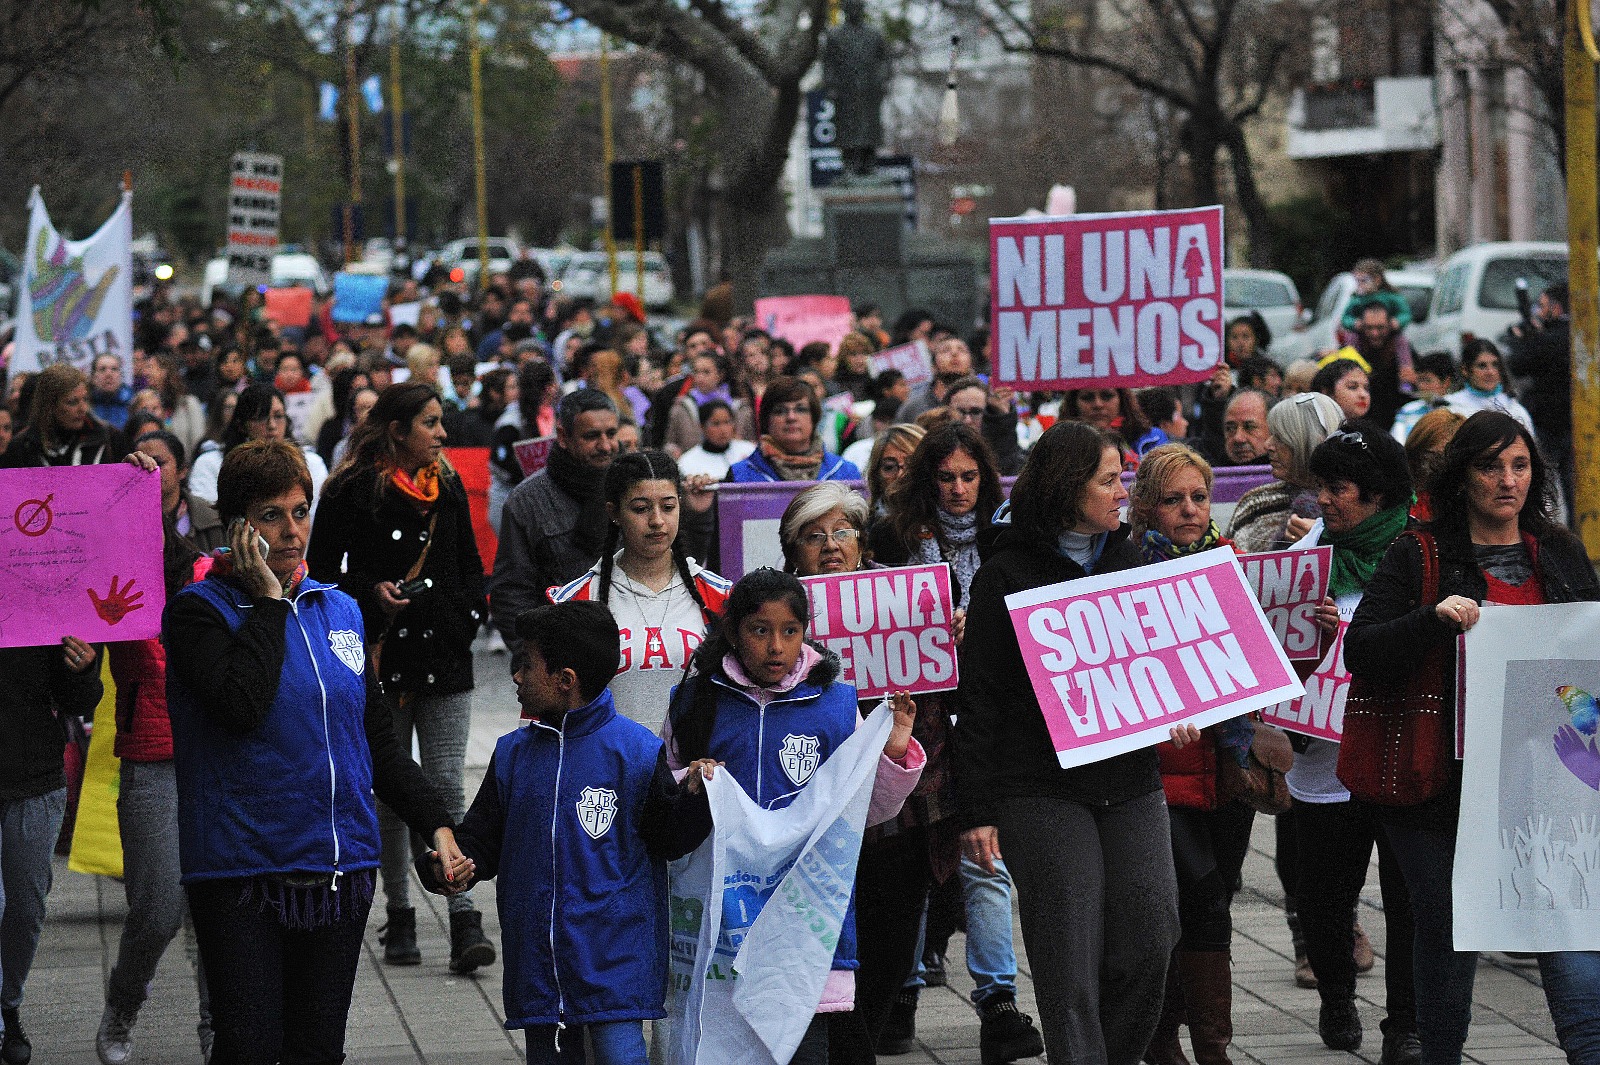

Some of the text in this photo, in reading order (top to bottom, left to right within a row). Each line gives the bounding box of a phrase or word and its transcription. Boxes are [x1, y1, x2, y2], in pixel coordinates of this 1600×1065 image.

[996, 222, 1216, 308] NI UNA
[997, 297, 1220, 382] MENOS
[839, 571, 946, 634] UNA
[1027, 574, 1230, 673] MENOS
[816, 627, 954, 690] ENOS
[1051, 656, 1185, 738] UNA
[1177, 633, 1259, 703] NI
